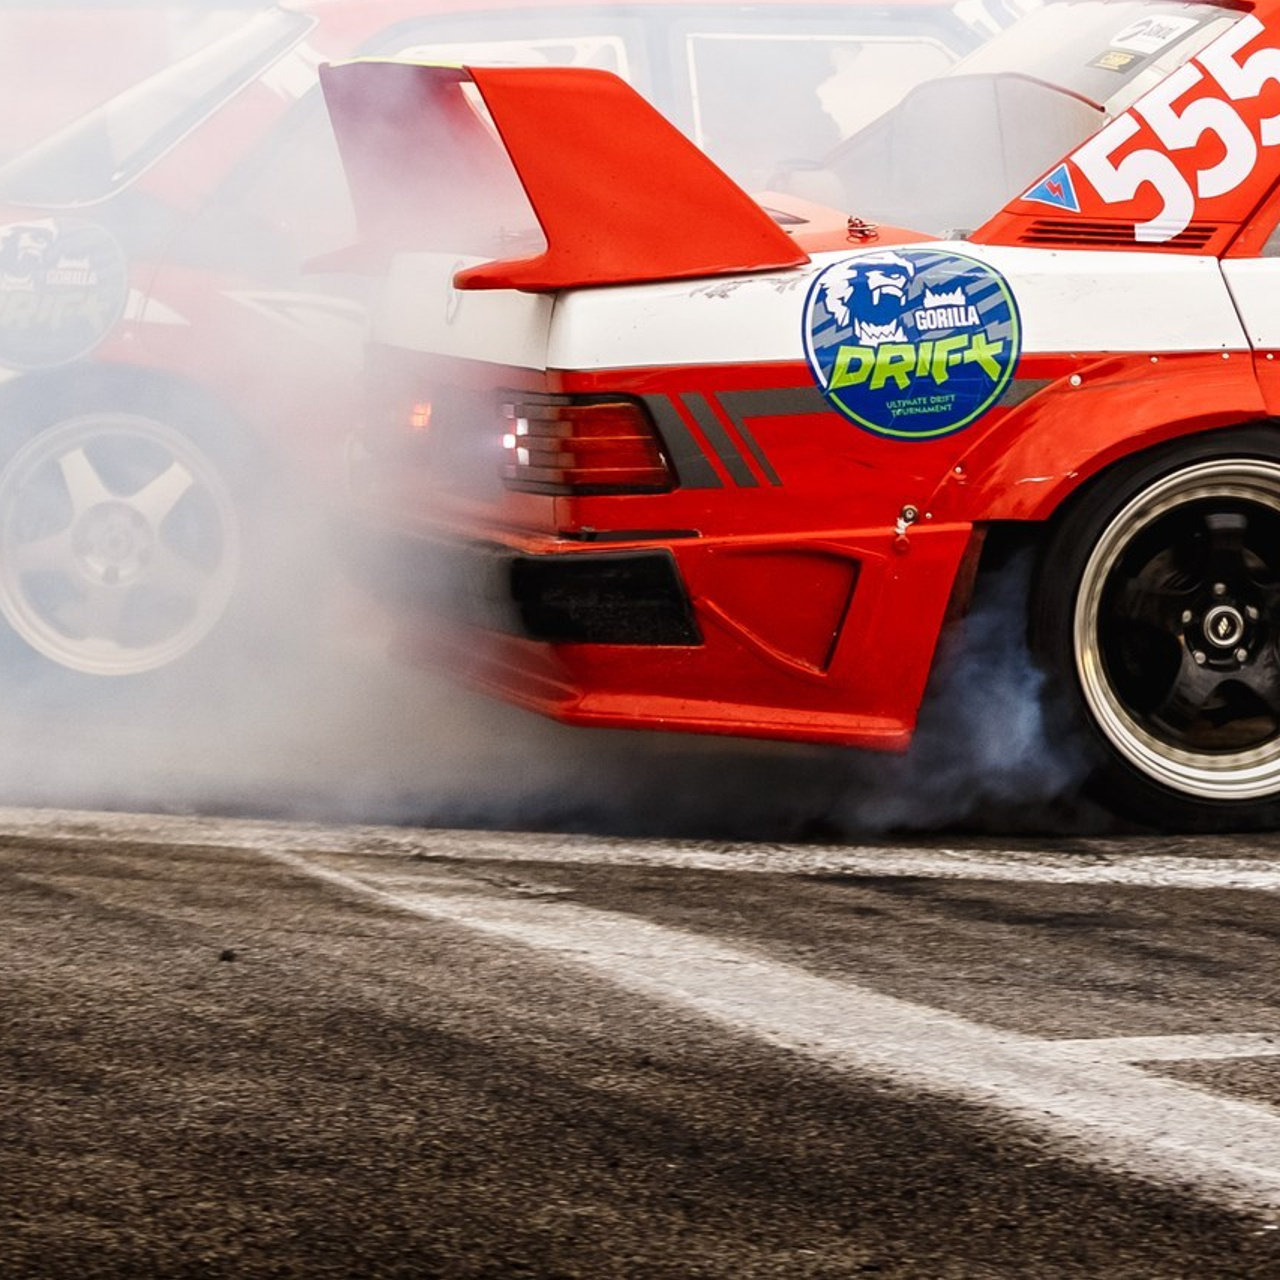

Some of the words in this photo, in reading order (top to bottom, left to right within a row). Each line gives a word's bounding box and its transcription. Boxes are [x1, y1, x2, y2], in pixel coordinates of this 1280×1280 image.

[46, 270, 98, 286] GORILLA
[0, 293, 110, 328] RIFT
[915, 305, 980, 330] GORILLA
[827, 334, 1004, 390] DRIFT
[886, 396, 927, 409] ULTIMATE
[930, 394, 955, 404] DRIFT
[891, 404, 952, 418] TOURNAMENT
